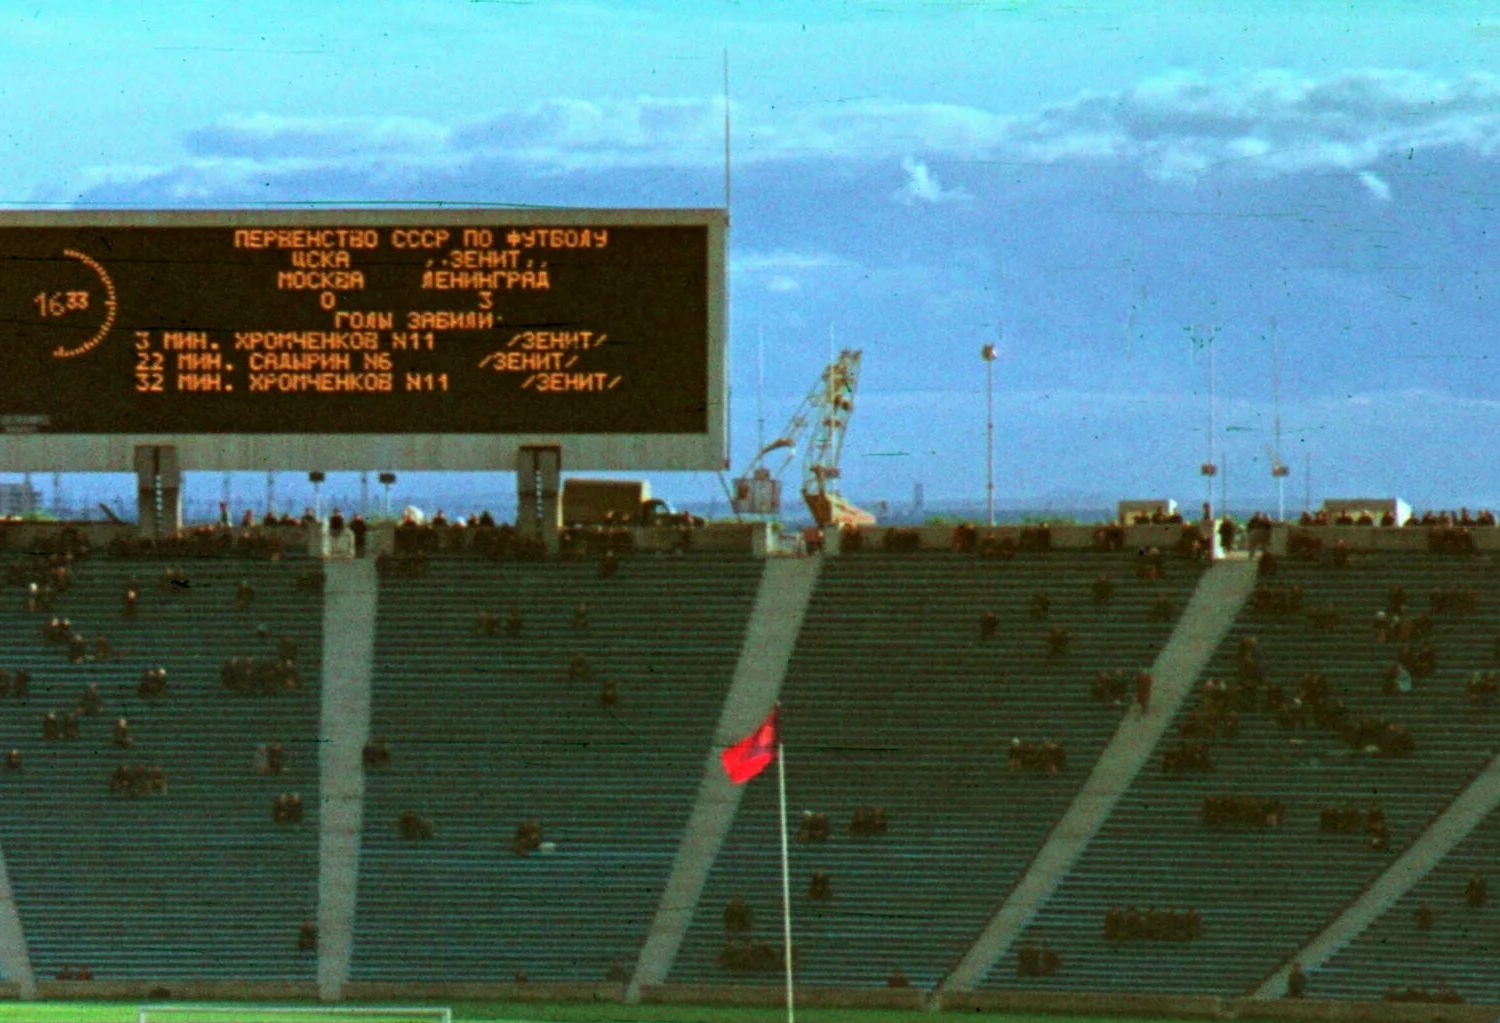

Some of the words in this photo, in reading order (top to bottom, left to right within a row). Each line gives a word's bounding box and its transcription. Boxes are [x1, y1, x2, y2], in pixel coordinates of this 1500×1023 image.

[234, 229, 379, 249] ПЕРВЕНСТВО
[391, 229, 450, 249] СССР
[463, 228, 493, 248] ПО
[506, 228, 608, 249] ФУТБОЛУ
[291, 250, 350, 269] ЦСКА
[277, 270, 365, 289] МОСКВА
[421, 270, 550, 289] ЛЕНИНГРАД
[478, 291, 493, 310] 3
[334, 312, 393, 330] ГОЛЫ
[135, 331, 150, 350] 3
[163, 331, 219, 350] МИН.
[234, 331, 379, 351] ХРОМЧЕНКОВ
[392, 331, 435, 350] N11
[507, 331, 607, 350] /ЗЕНИТ/
[135, 352, 164, 372] 22
[177, 352, 234, 371] МИН.
[248, 352, 350, 371] САДЫРИН
[478, 352, 579, 371] /ЗЕНИТ/
[135, 372, 164, 392] 32
[177, 373, 233, 392] МИН.
[249, 372, 393, 392] ХРОМЧЕНКОВ
[406, 373, 449, 392] N11
[521, 372, 622, 392] /ЗЕНИТ/
